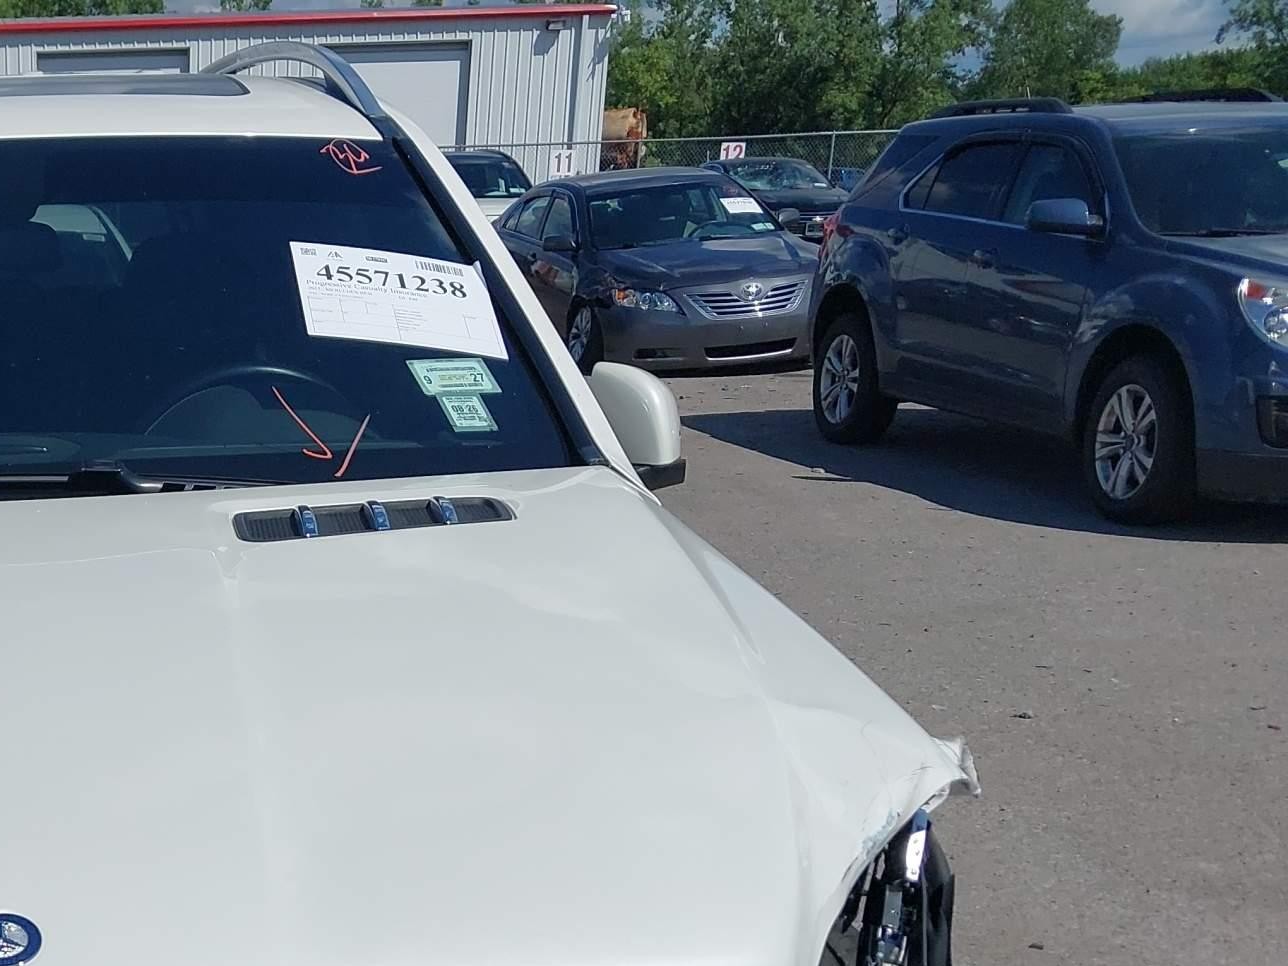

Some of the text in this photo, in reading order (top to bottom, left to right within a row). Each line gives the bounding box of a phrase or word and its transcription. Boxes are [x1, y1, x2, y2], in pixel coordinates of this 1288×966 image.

[723, 144, 743, 159] 12
[554, 152, 572, 173] 11
[316, 264, 467, 298] 45571238
[423, 375, 433, 385] 9
[469, 372, 485, 382] 27
